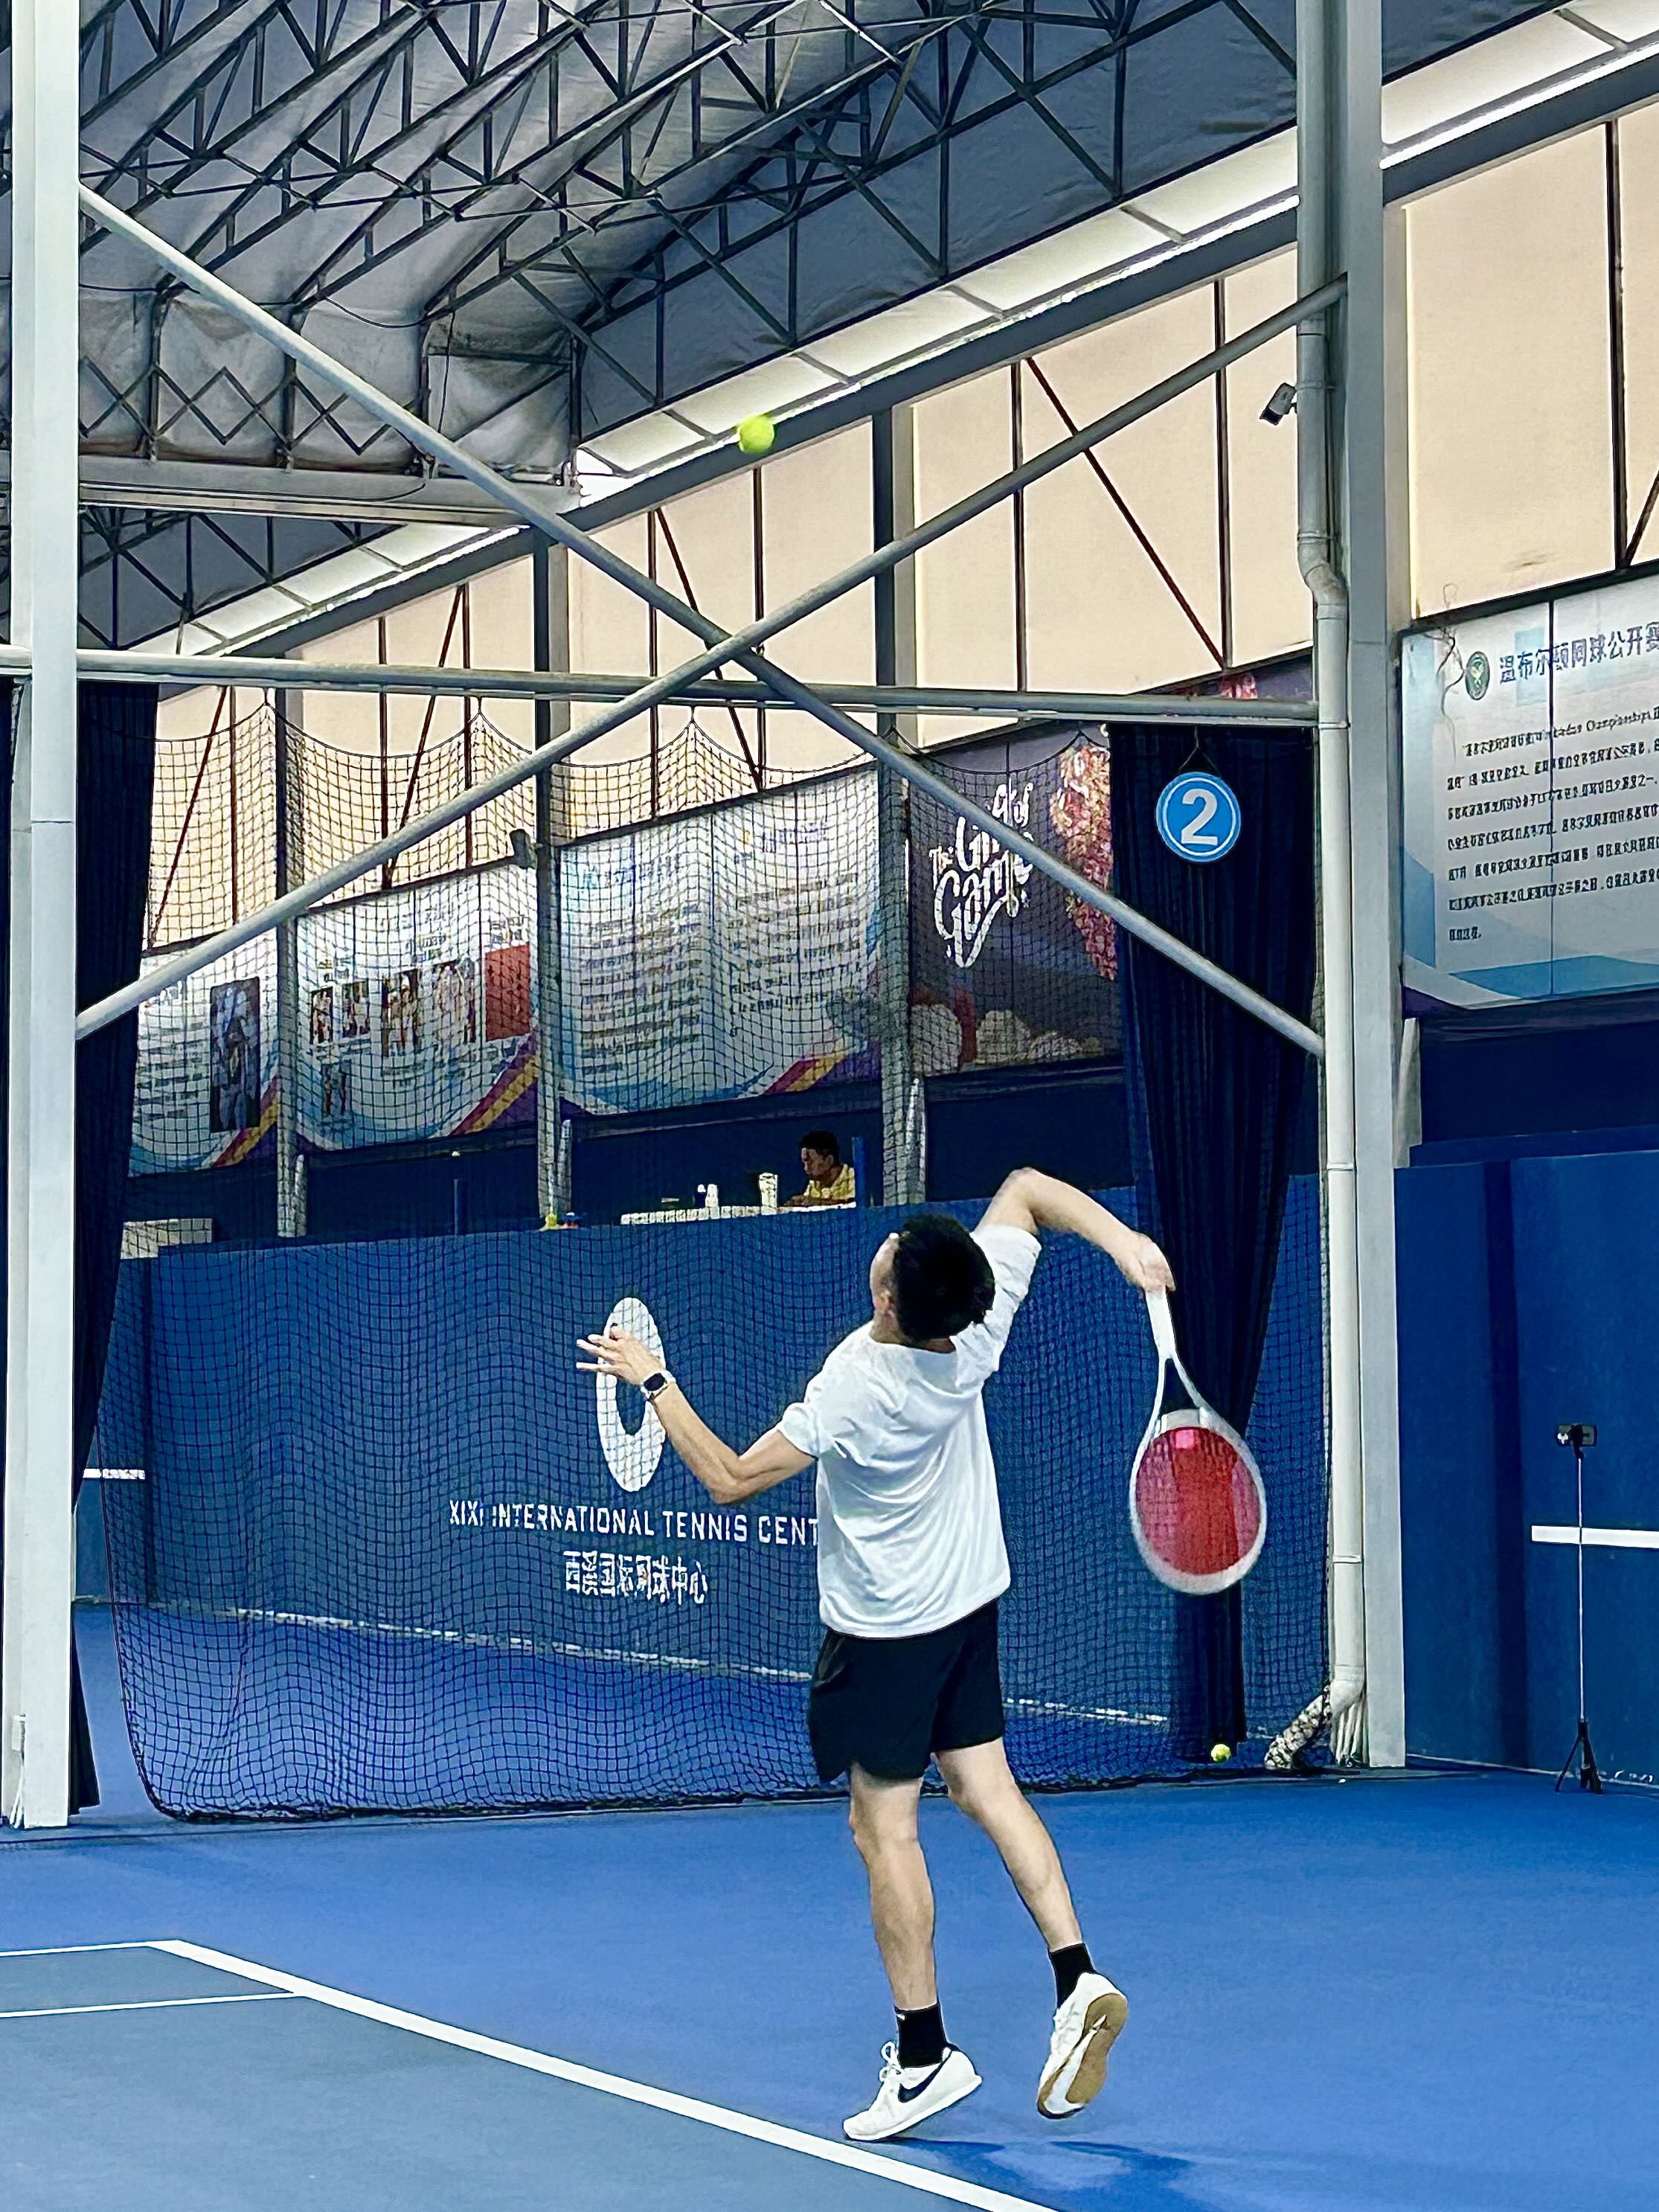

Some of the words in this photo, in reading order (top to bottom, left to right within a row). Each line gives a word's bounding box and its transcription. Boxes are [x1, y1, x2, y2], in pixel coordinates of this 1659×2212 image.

[1181, 788, 1219, 845] 2
[491, 1502, 655, 1536] INTERNATIONAL
[662, 1510, 747, 1542] TENNIS
